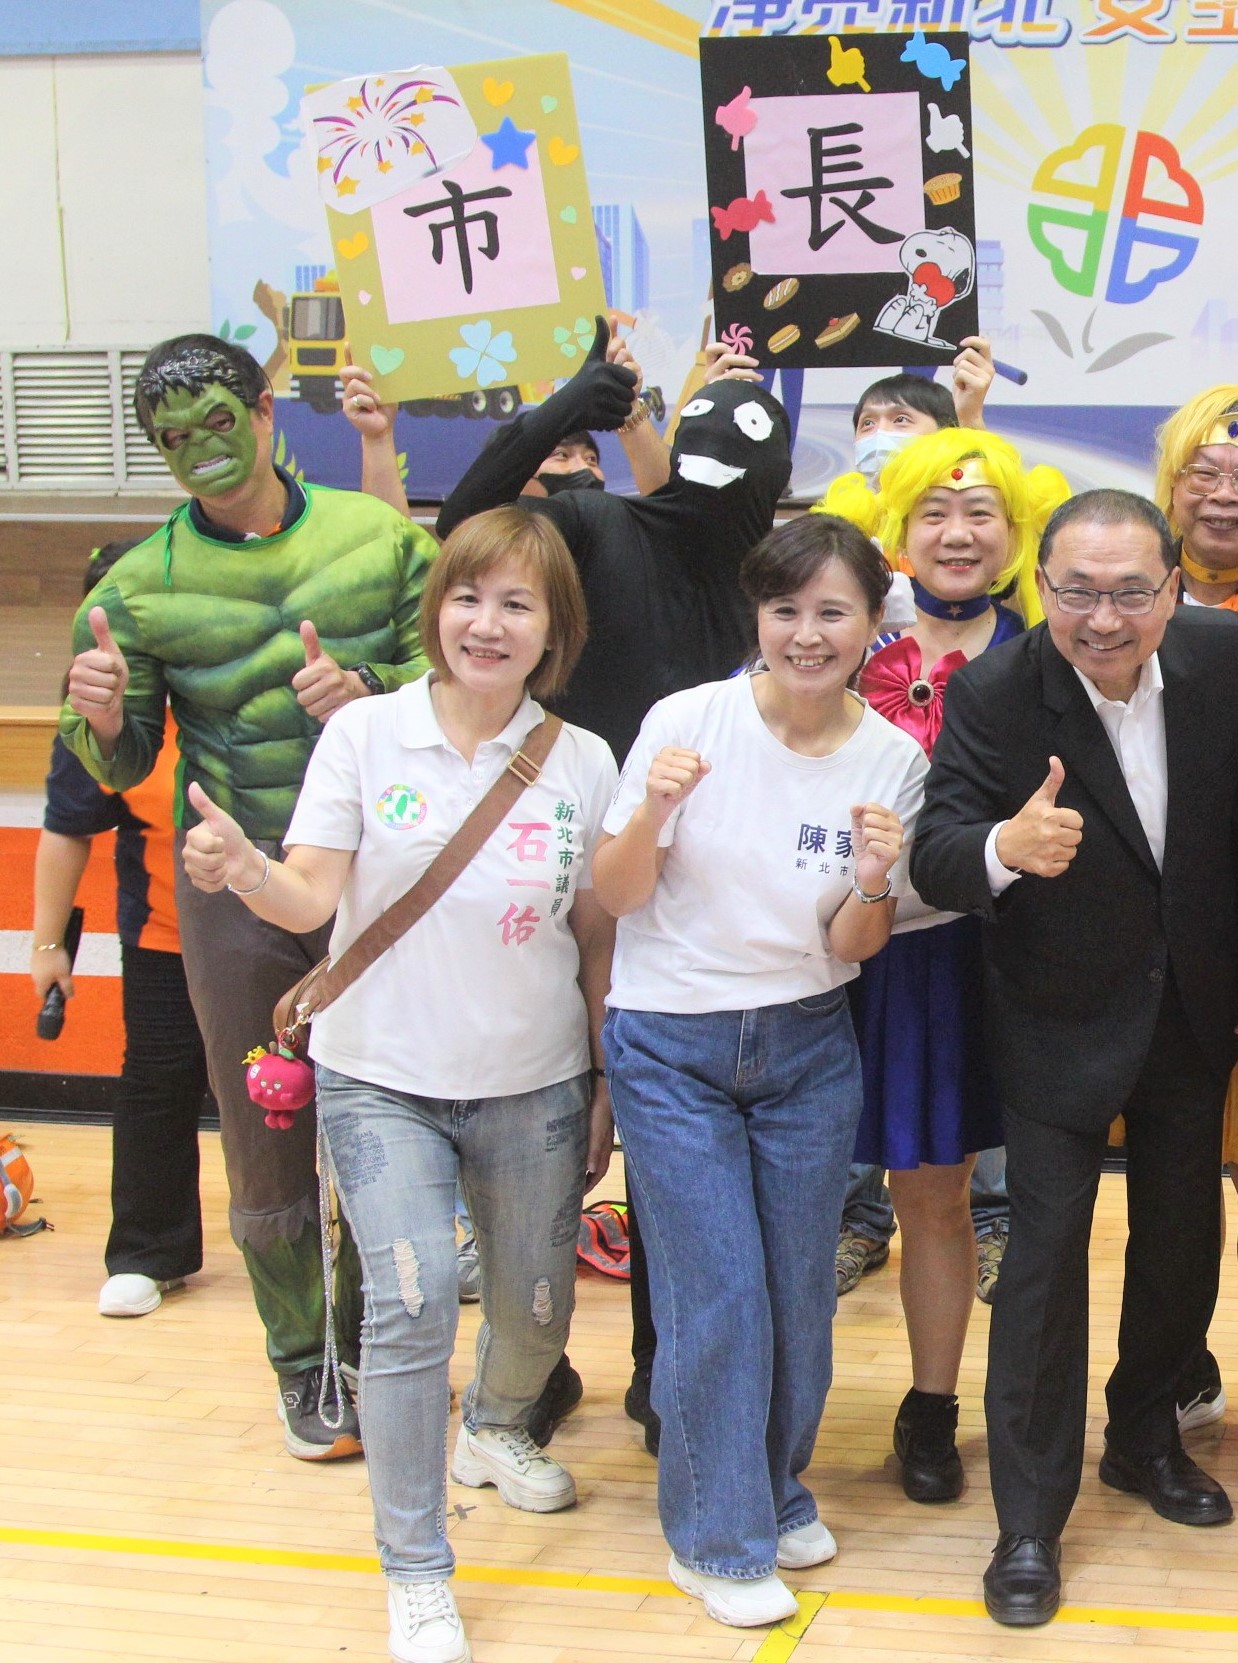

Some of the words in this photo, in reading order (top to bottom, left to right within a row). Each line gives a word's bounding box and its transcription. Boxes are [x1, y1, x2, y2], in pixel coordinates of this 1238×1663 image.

[402, 179, 513, 295] 市
[781, 122, 906, 252] 長
[496, 821, 552, 947] 石一佑
[549, 799, 576, 918] 新北市議員
